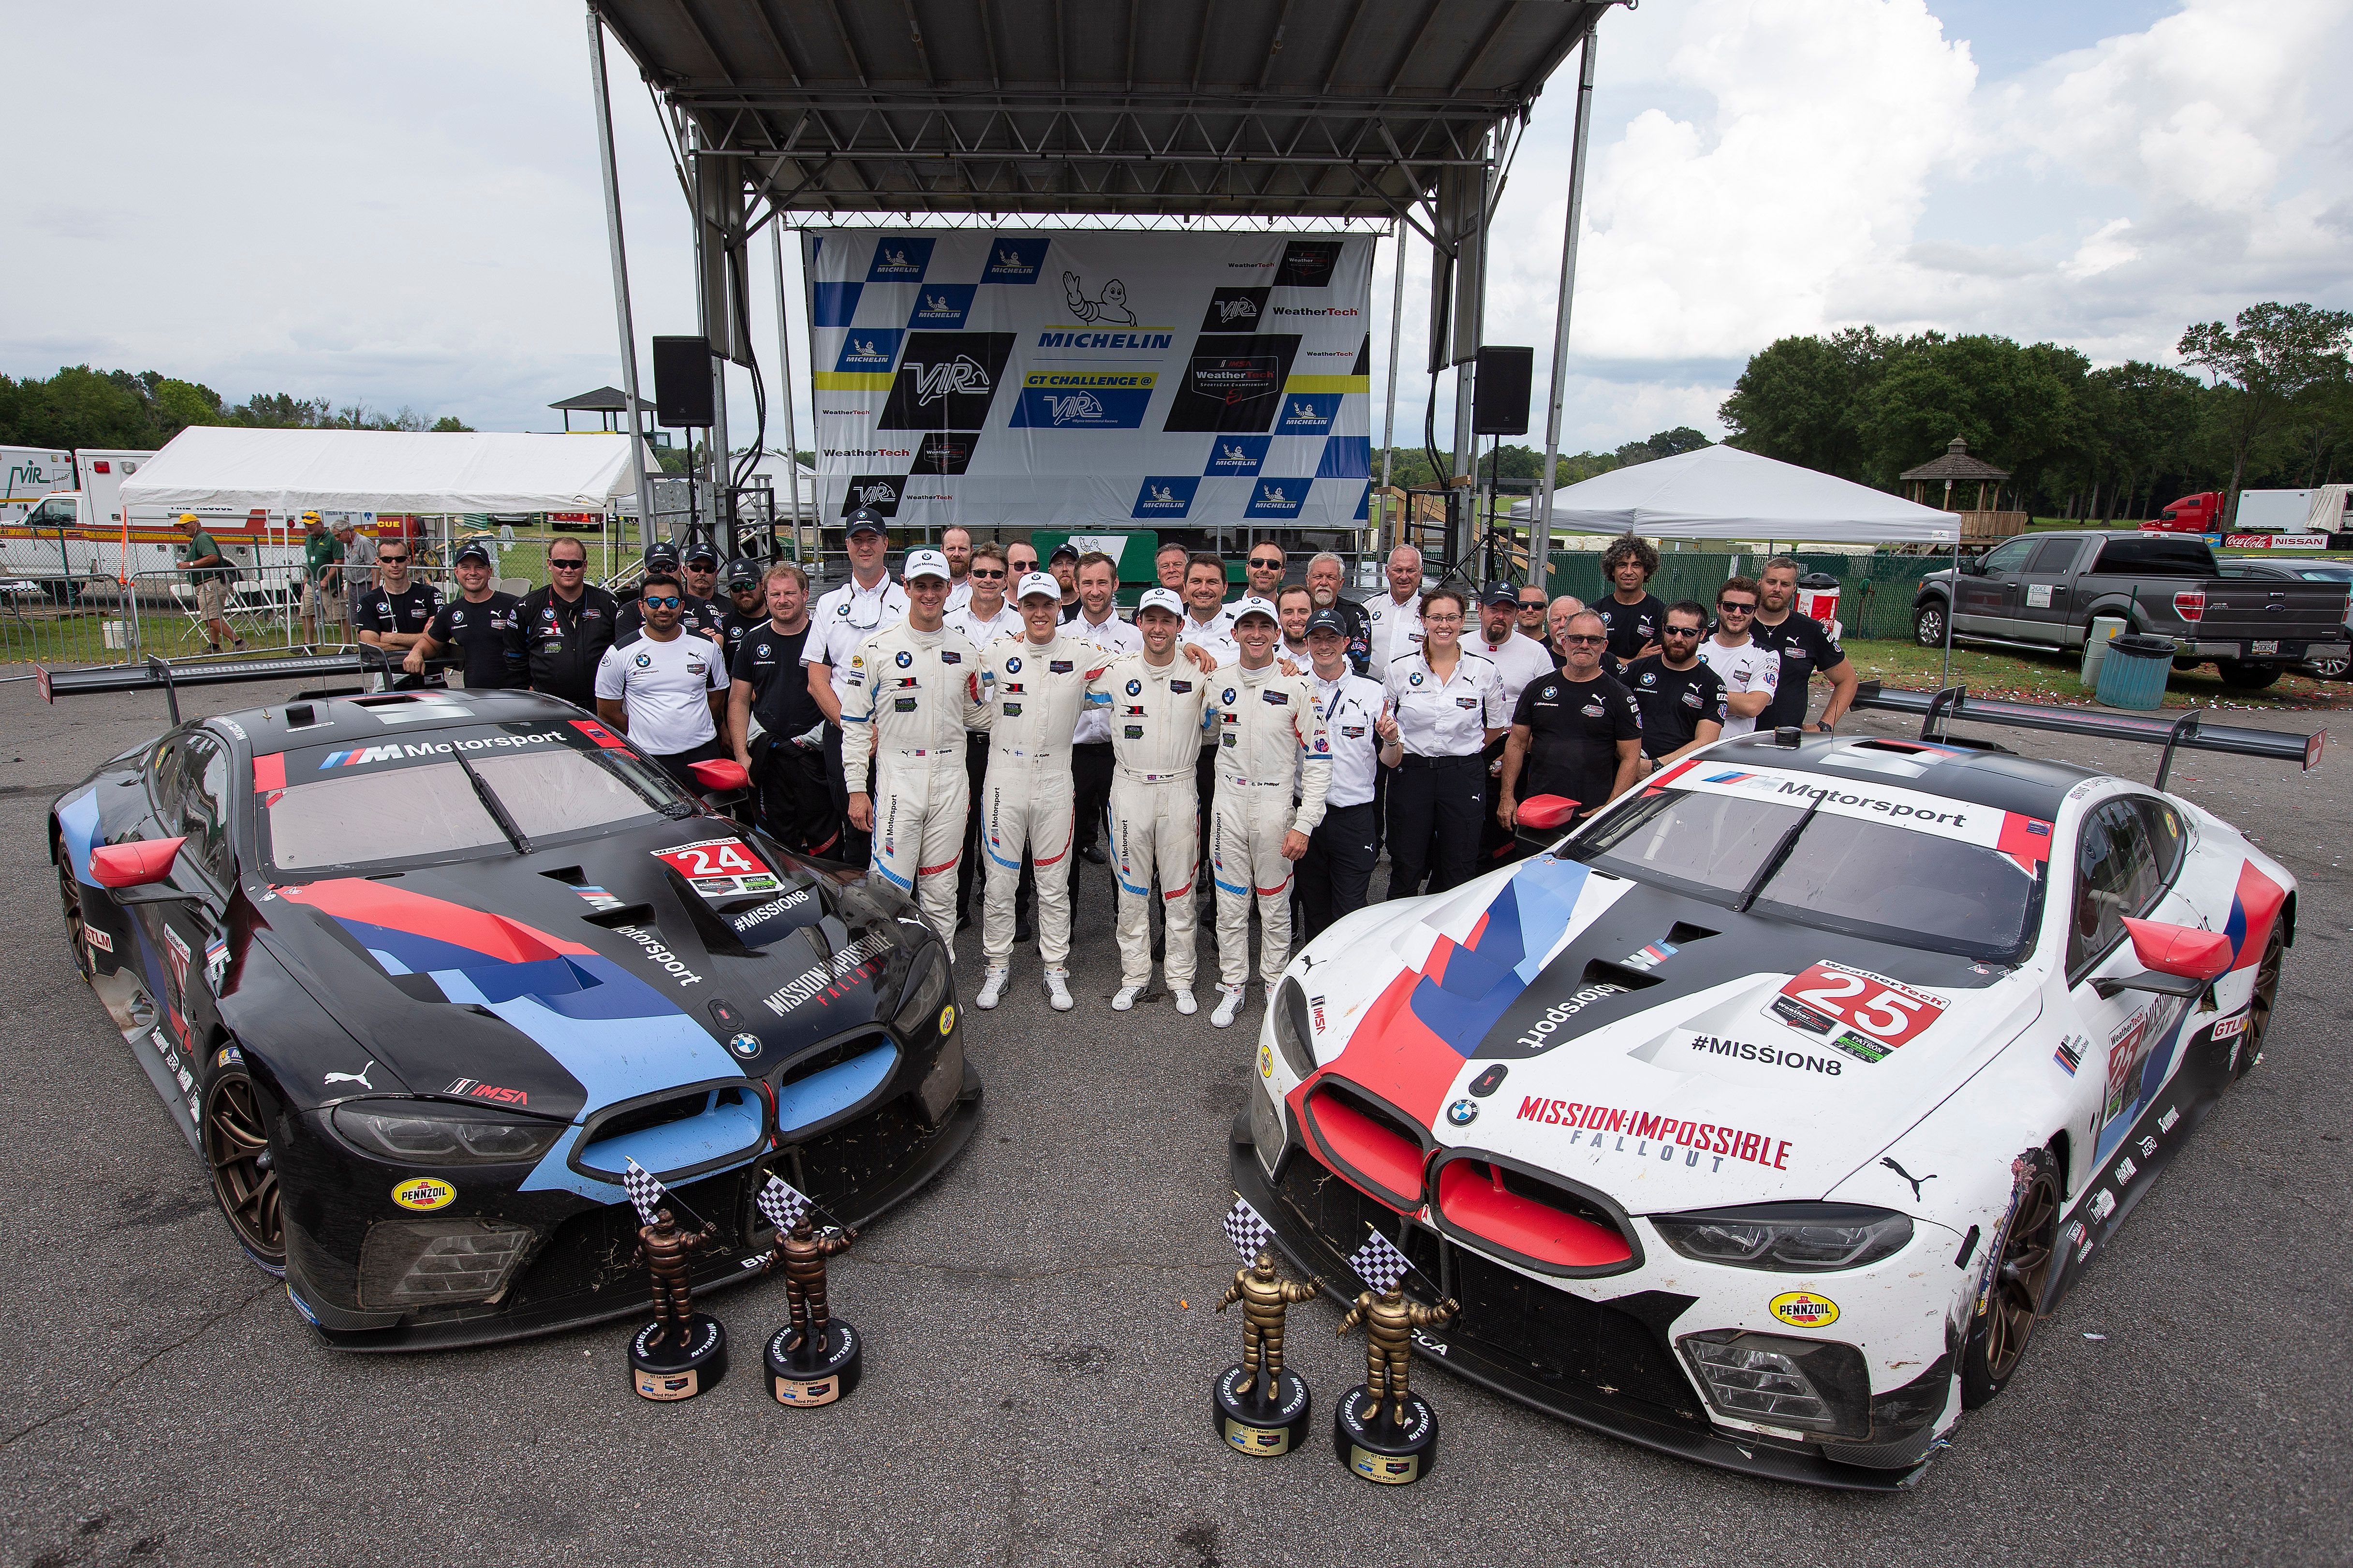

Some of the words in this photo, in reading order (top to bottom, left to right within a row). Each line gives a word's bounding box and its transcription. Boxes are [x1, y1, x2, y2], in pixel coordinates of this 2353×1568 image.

[1273, 307, 1359, 316] WeatherTech
[1037, 332, 1173, 349] MICHELIN
[1028, 376, 1047, 385] GT
[1049, 376, 1138, 386] CHALLENGE
[1196, 370, 1275, 379] WeatherTech
[823, 448, 911, 457] WeatherTech
[2225, 535, 2268, 548] Coca-Cola
[404, 730, 568, 757] Motorsport
[886, 794, 897, 836] Motorsport
[992, 786, 1000, 828] Motorsport
[1777, 781, 1967, 828] Motorsport
[654, 836, 737, 855] WeatherTech
[677, 846, 753, 875] 24
[734, 890, 810, 932] #MISSION8
[85, 925, 112, 951] GTLM
[165, 927, 191, 961] WeatherTech
[762, 929, 895, 1017] MISSION:IMPOSSIBLE
[815, 955, 886, 1006] FALLOUT
[1825, 960, 1943, 1007] WeatherTech
[1313, 1007, 1326, 1036] IMSA
[1778, 1001, 1830, 1029] WeatherTech
[1794, 971, 1924, 1037] 25
[1852, 1036, 1883, 1053] PATRÓN
[2110, 1010, 2144, 1046] WeatherTech
[165, 1054, 179, 1072] AERO
[1692, 1035, 1842, 1076] #MISSION8
[2109, 1032, 2139, 1088] 25
[471, 1084, 528, 1105] IMSA
[1516, 1095, 1793, 1171] MISSION:IMPOSSIBLE
[1570, 1129, 1724, 1173] FALLOUT
[2141, 1138, 2158, 1158] AERO
[401, 1185, 448, 1202] PENNZOIL
[1779, 1303, 1831, 1316] PENNZOIL
[635, 1322, 658, 1358] MICHELIN
[691, 1322, 717, 1358] MICHELIN
[772, 1326, 792, 1363] MICHELIN
[829, 1327, 853, 1363] MICHELIN
[1222, 1367, 1240, 1407] MICHELIN
[1282, 1377, 1304, 1415] MICHELIN
[1344, 1391, 1364, 1432] MICHELIN
[1408, 1402, 1429, 1441] MICHELIN
